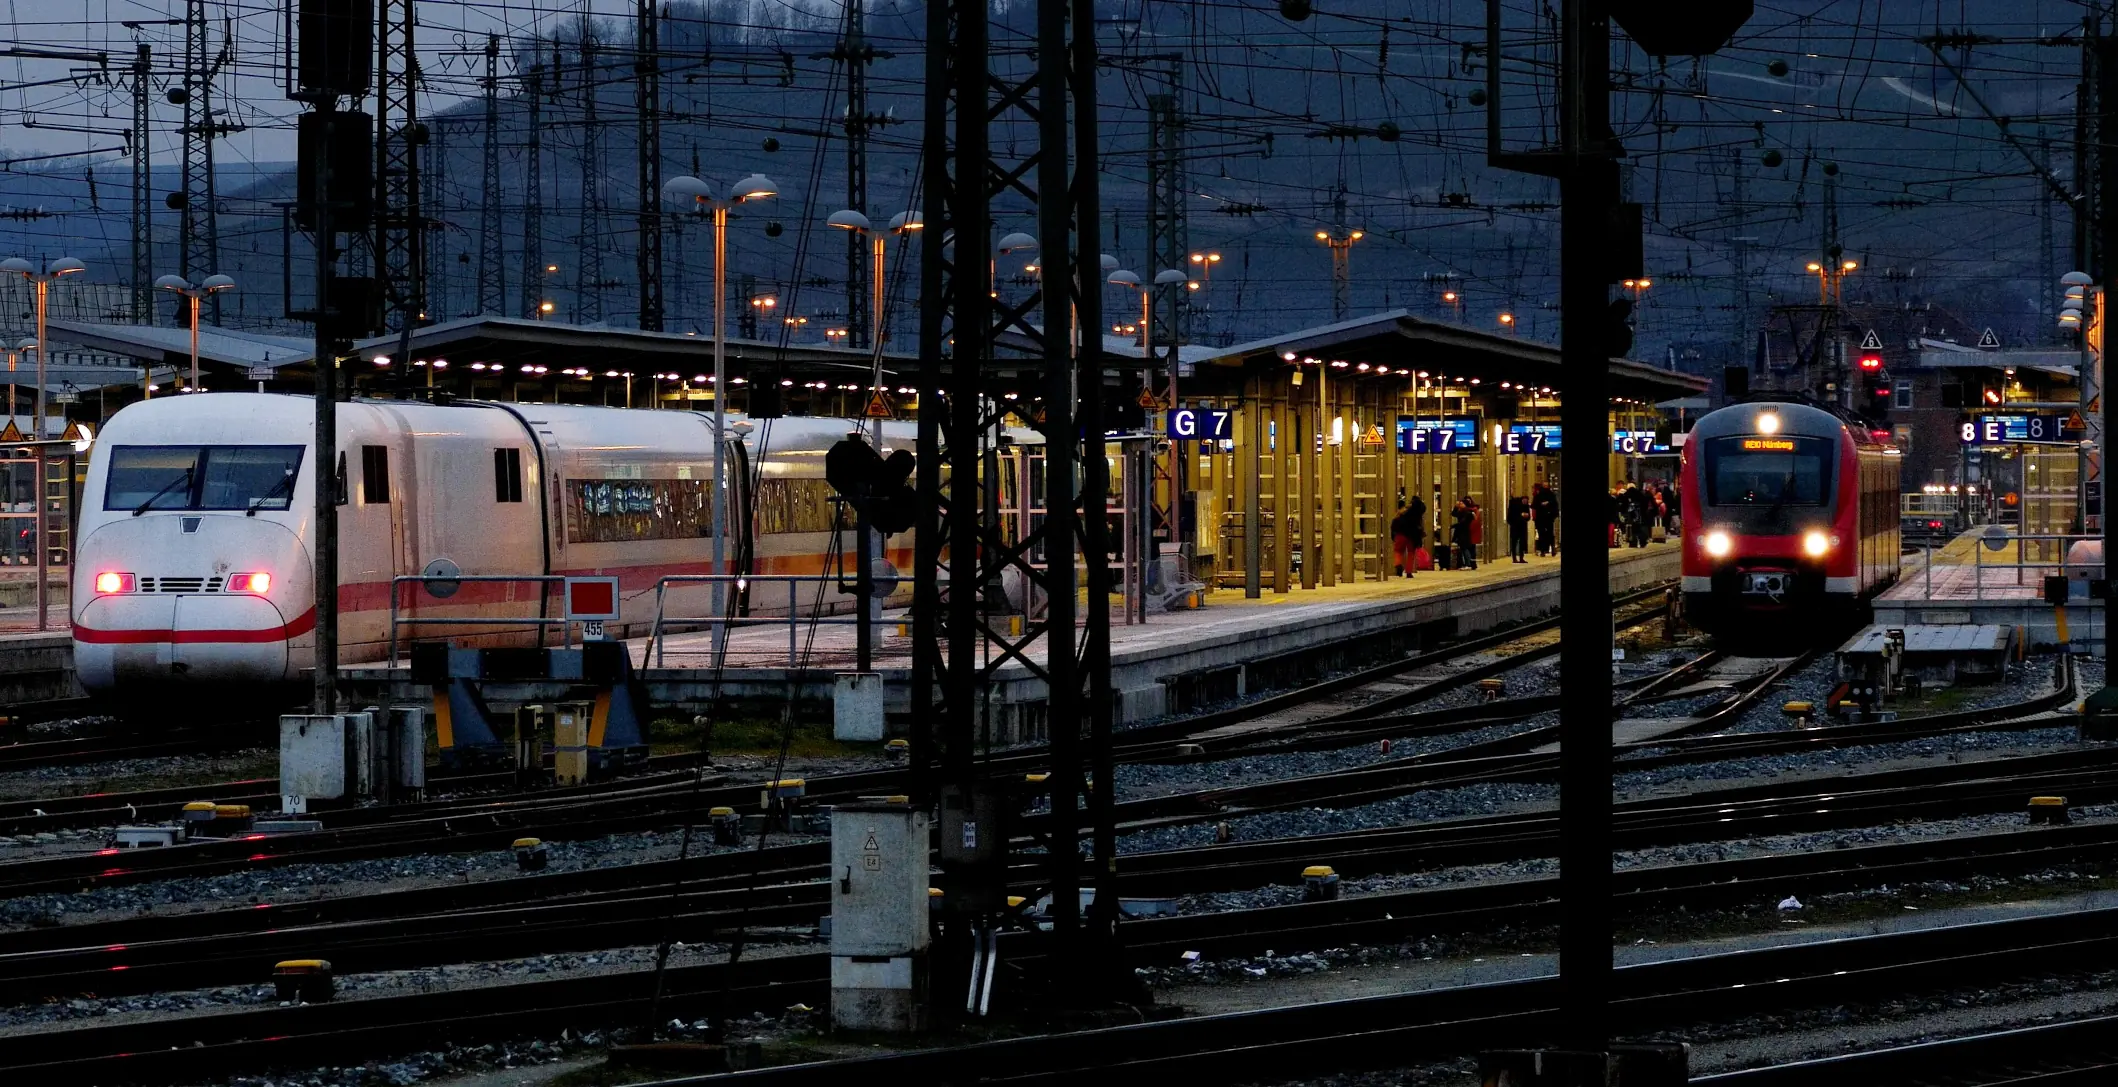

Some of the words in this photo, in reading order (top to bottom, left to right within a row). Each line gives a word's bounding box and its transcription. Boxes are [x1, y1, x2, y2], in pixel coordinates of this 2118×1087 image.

[1868, 337, 1874, 347] 6
[1986, 333, 1992, 344] 6
[1175, 410, 1195, 436] G
[1212, 411, 1228, 436] 7
[1961, 422, 1975, 441] 8
[1985, 422, 1999, 441] E
[2030, 418, 2044, 438] 8
[1412, 429, 1426, 451] F
[1439, 429, 1454, 451] 7
[1507, 433, 1520, 452] E
[1530, 433, 1543, 452] 7
[1622, 437, 1634, 453] C
[1642, 437, 1653, 452] 7
[584, 622, 603, 636] 455
[288, 795, 300, 806] 70
